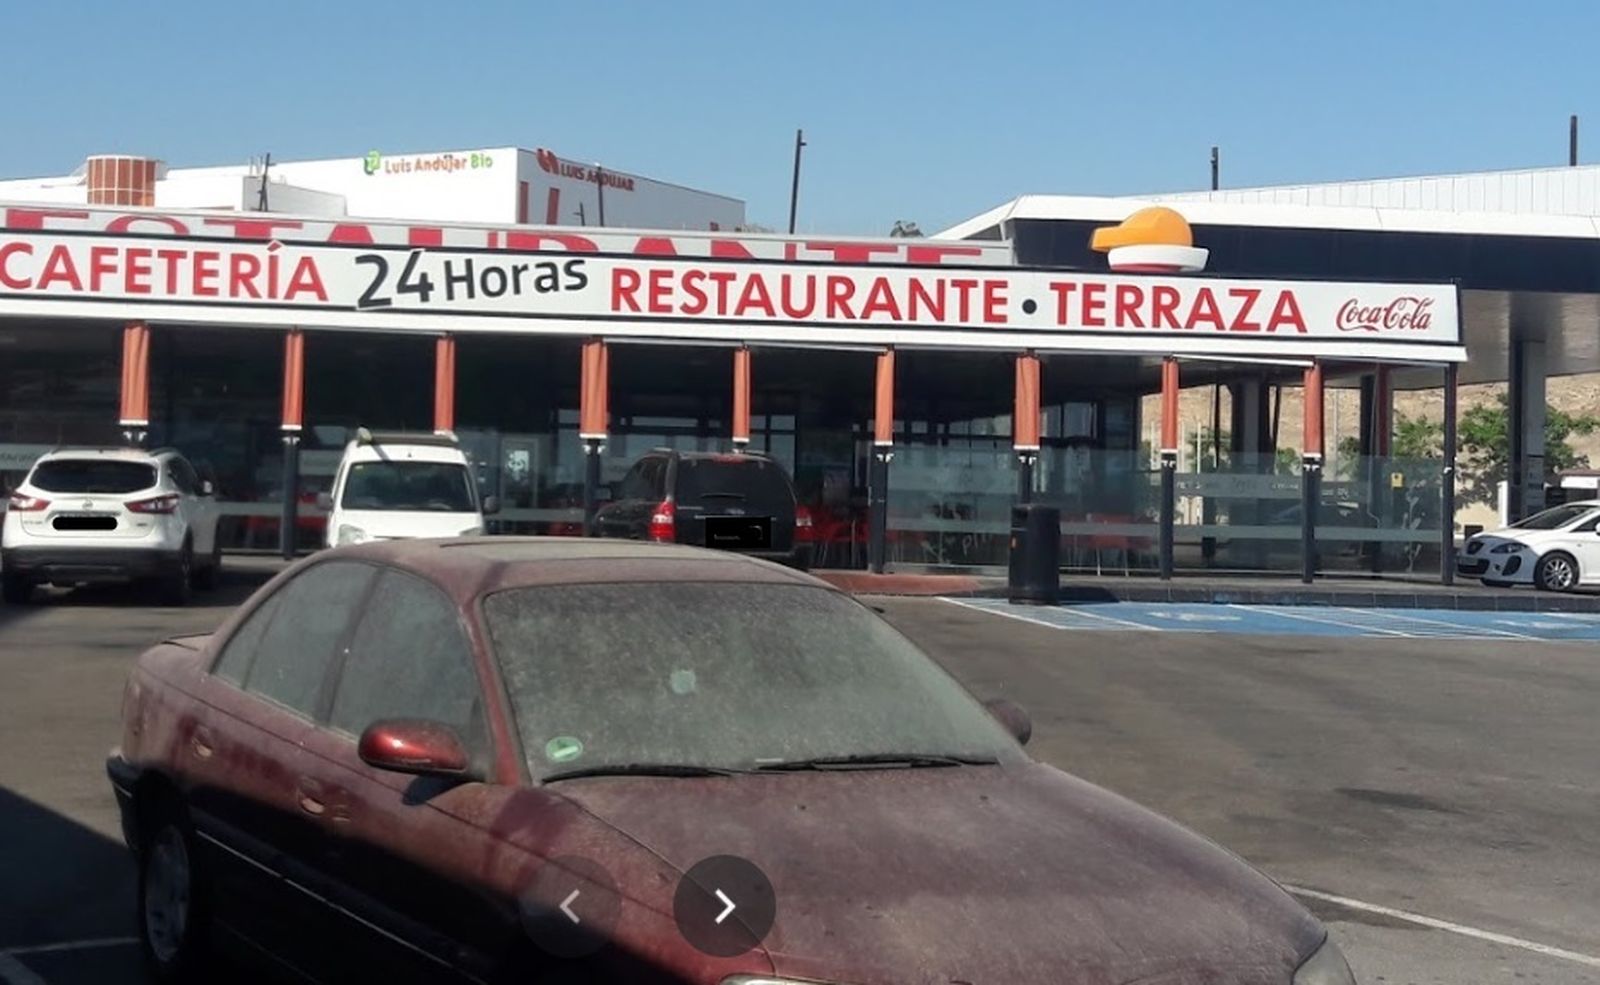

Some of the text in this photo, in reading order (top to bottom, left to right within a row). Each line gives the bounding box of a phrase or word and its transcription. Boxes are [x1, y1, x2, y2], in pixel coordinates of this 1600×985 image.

[385, 159, 411, 174] Luis
[470, 153, 493, 169] Bio
[561, 163, 585, 181] LUIS
[0, 240, 1308, 333] CAFETERÍA 24 Horas RESTAURANTE TERRAZA
